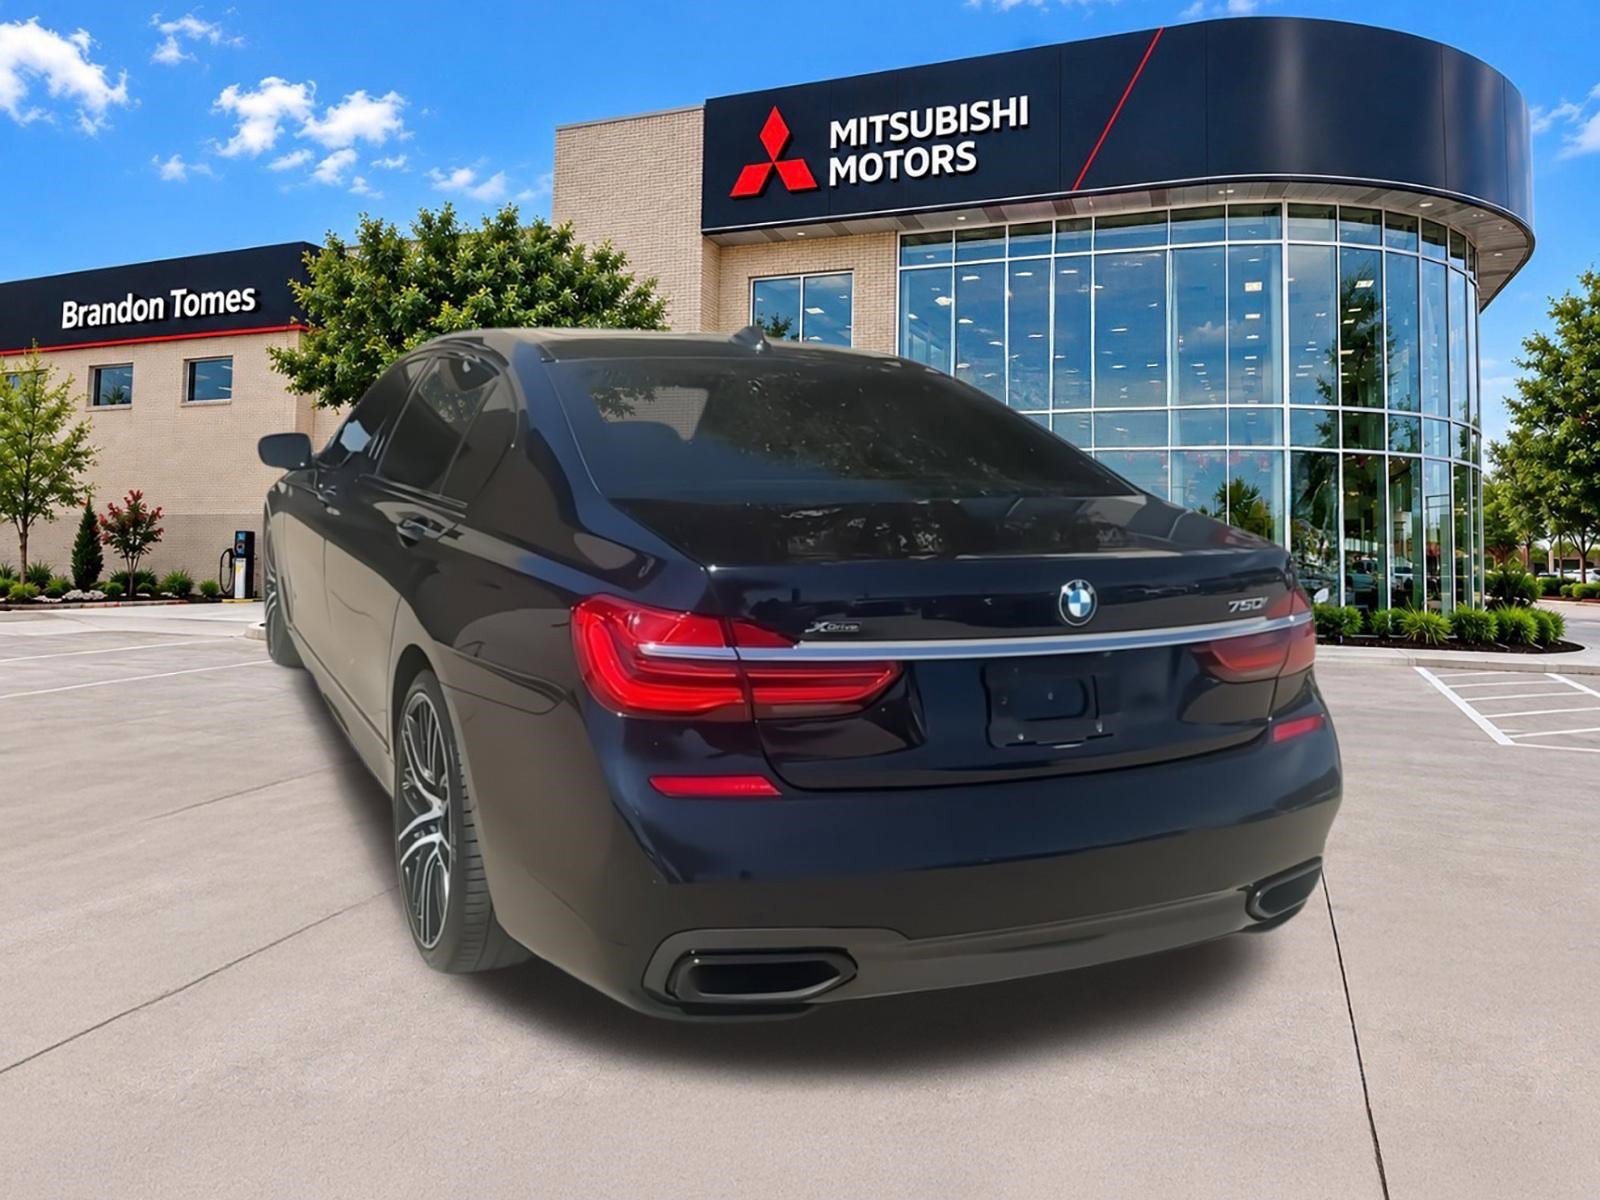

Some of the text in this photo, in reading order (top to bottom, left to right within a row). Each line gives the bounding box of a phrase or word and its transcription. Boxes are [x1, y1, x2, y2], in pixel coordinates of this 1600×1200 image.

[829, 95, 1028, 149] MITSUBISHI
[828, 141, 977, 187] MOTORS
[61, 287, 255, 329] Brandon Tomes
